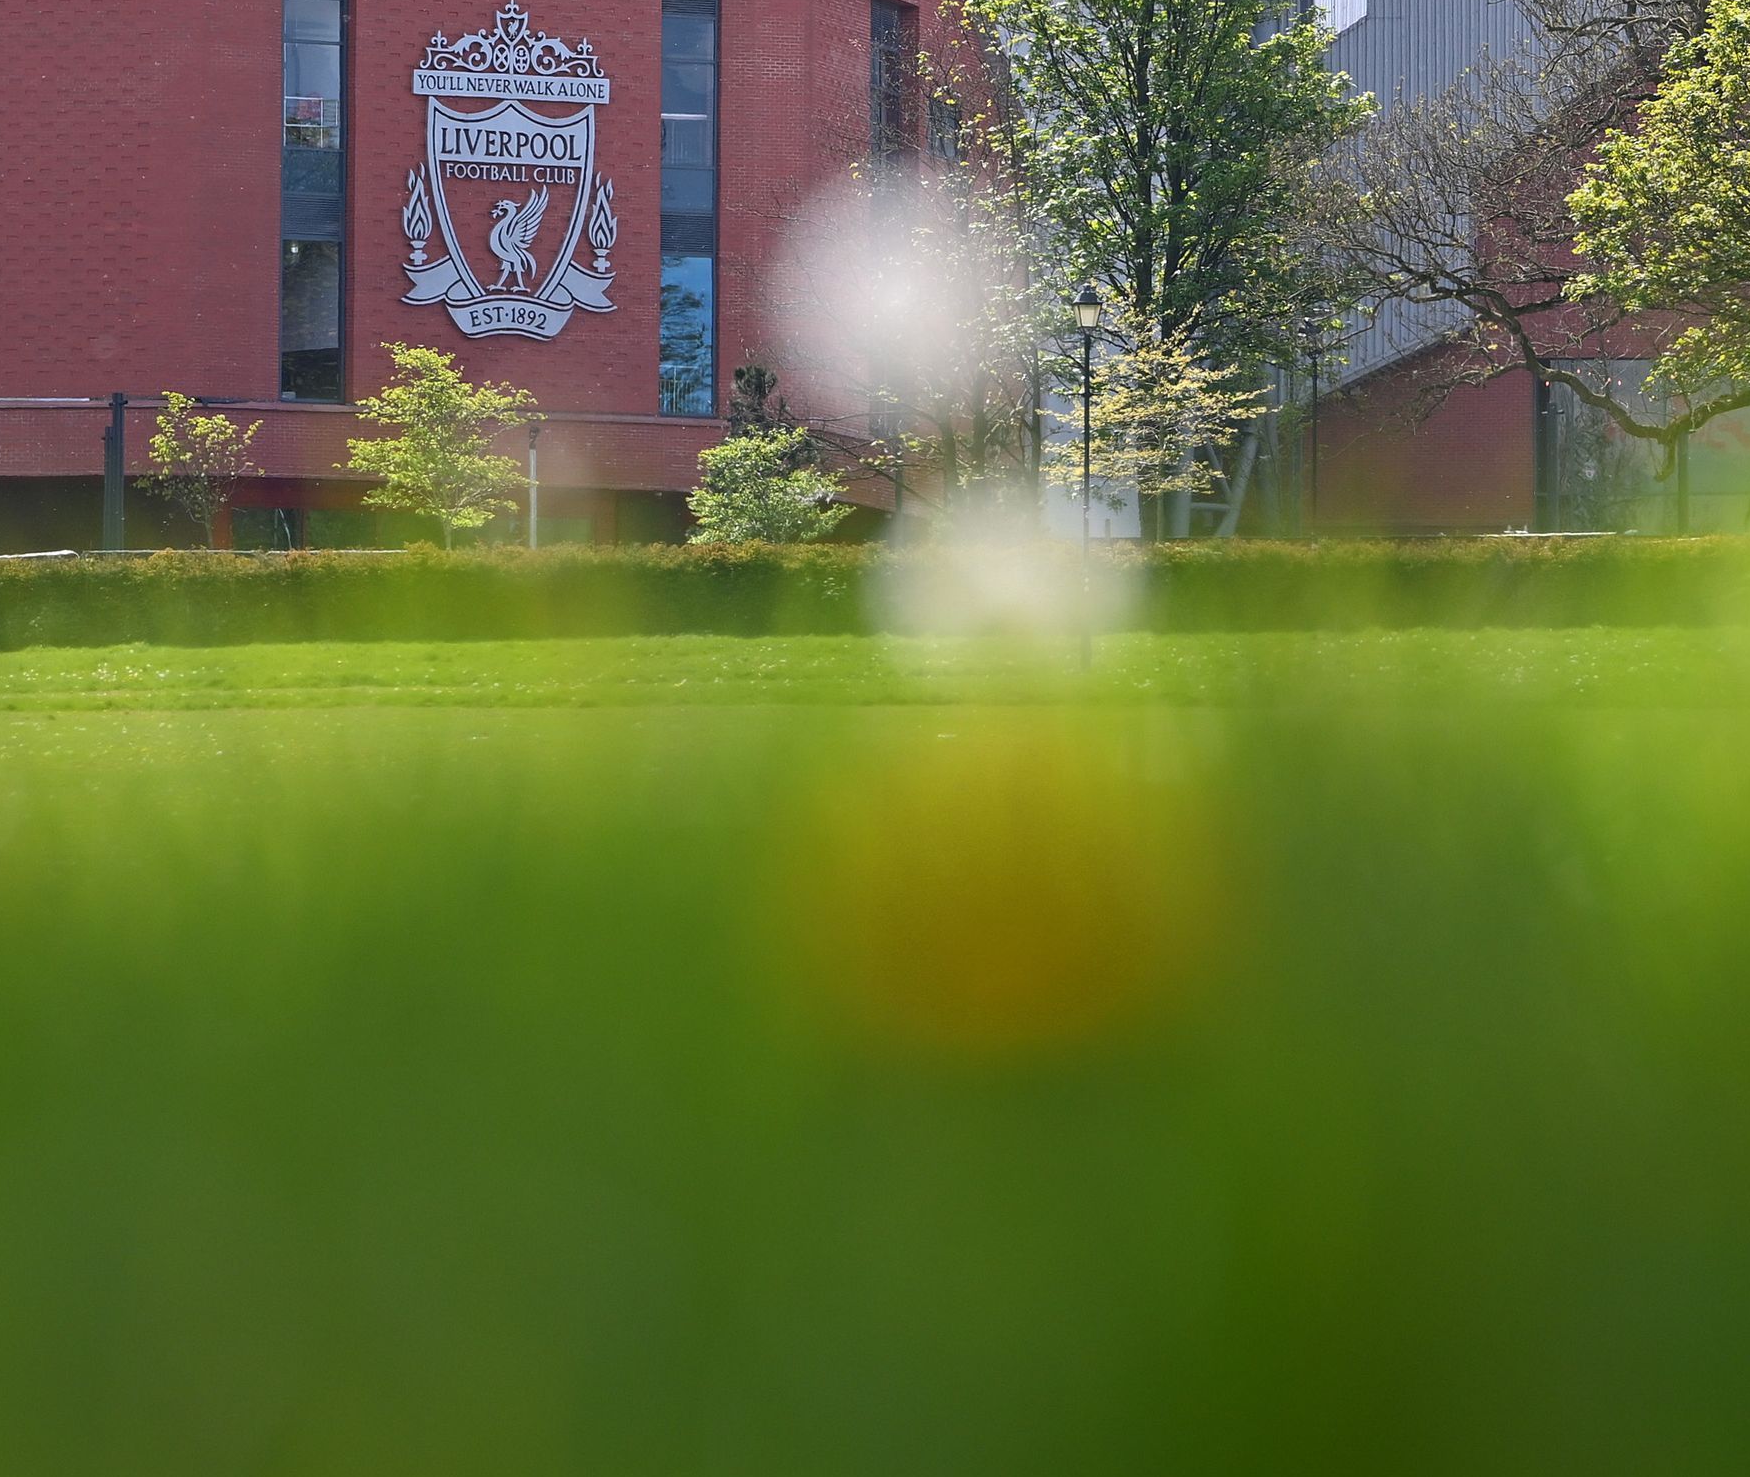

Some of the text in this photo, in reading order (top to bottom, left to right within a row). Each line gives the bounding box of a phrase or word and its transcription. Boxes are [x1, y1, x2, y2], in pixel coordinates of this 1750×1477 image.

[418, 74, 605, 99] YOU'LL NEVER WALK ALONE
[440, 127, 582, 161] LIVERPOOL
[446, 163, 575, 184] FOOTBALL CLUB
